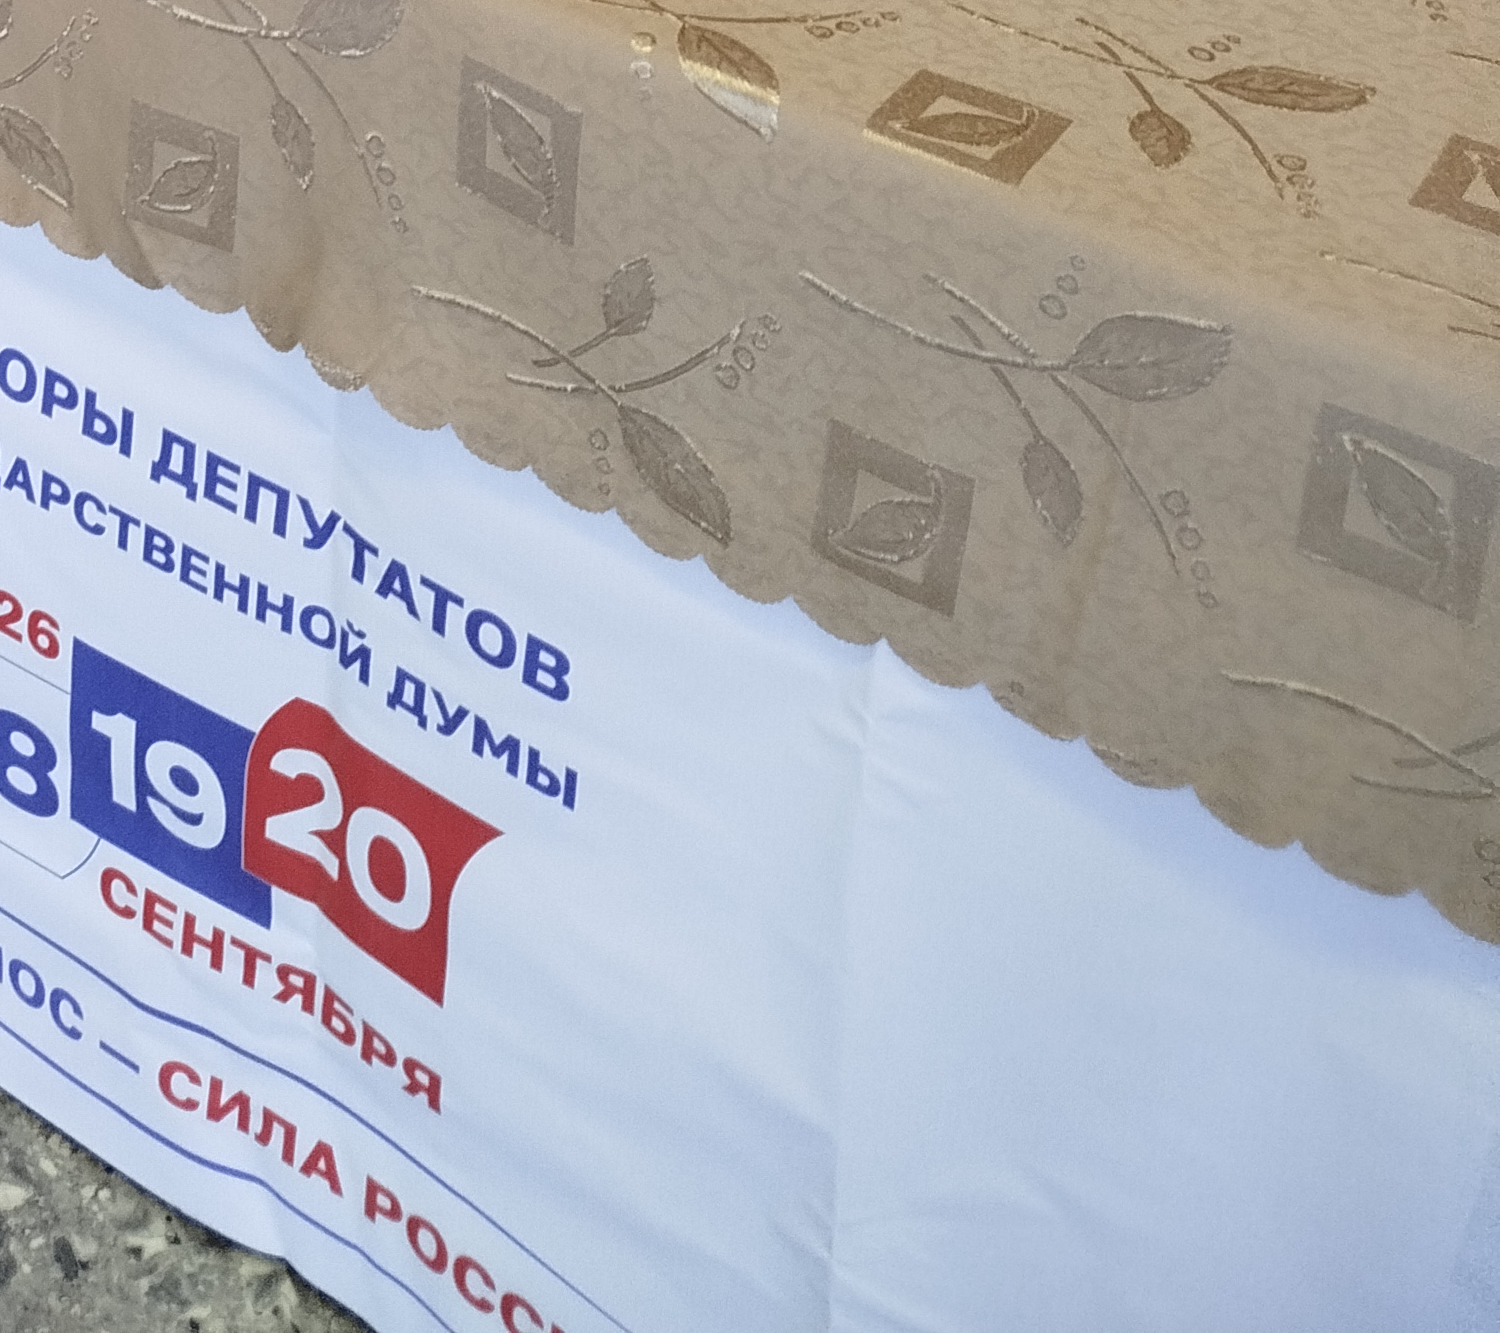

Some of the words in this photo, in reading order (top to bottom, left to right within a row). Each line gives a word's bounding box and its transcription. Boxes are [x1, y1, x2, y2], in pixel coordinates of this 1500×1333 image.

[149, 426, 572, 702] ДЕПУТАТОВ
[91, 708, 228, 850] 19
[265, 747, 431, 932] 20
[386, 665, 578, 811] ДУМЫ
[100, 866, 443, 1116] СЕНТЯБРЯ
[158, 1060, 344, 1199] СИЛА
[364, 1174, 566, 1333] РОСС
